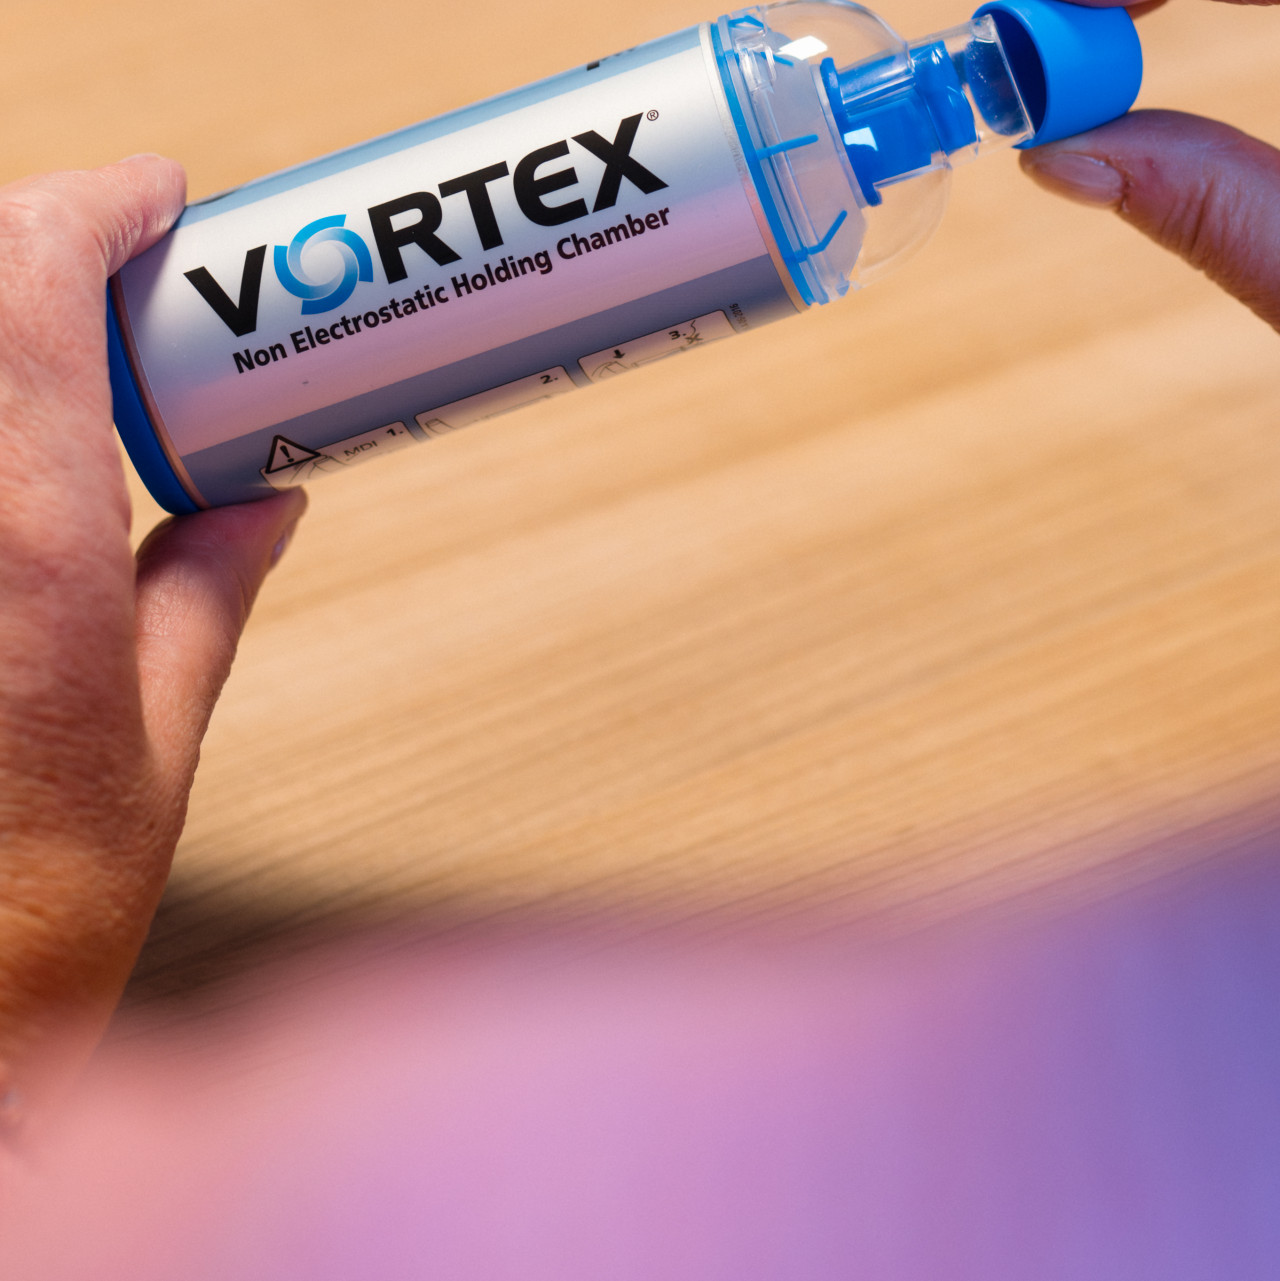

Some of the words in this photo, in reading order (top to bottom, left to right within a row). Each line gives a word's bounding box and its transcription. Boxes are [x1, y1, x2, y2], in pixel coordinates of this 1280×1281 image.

[232, 342, 288, 375] Non
[290, 280, 449, 355] Electrostatic
[450, 248, 554, 299] Holding
[556, 206, 671, 261] Chamber
[343, 439, 379, 458] MDI
